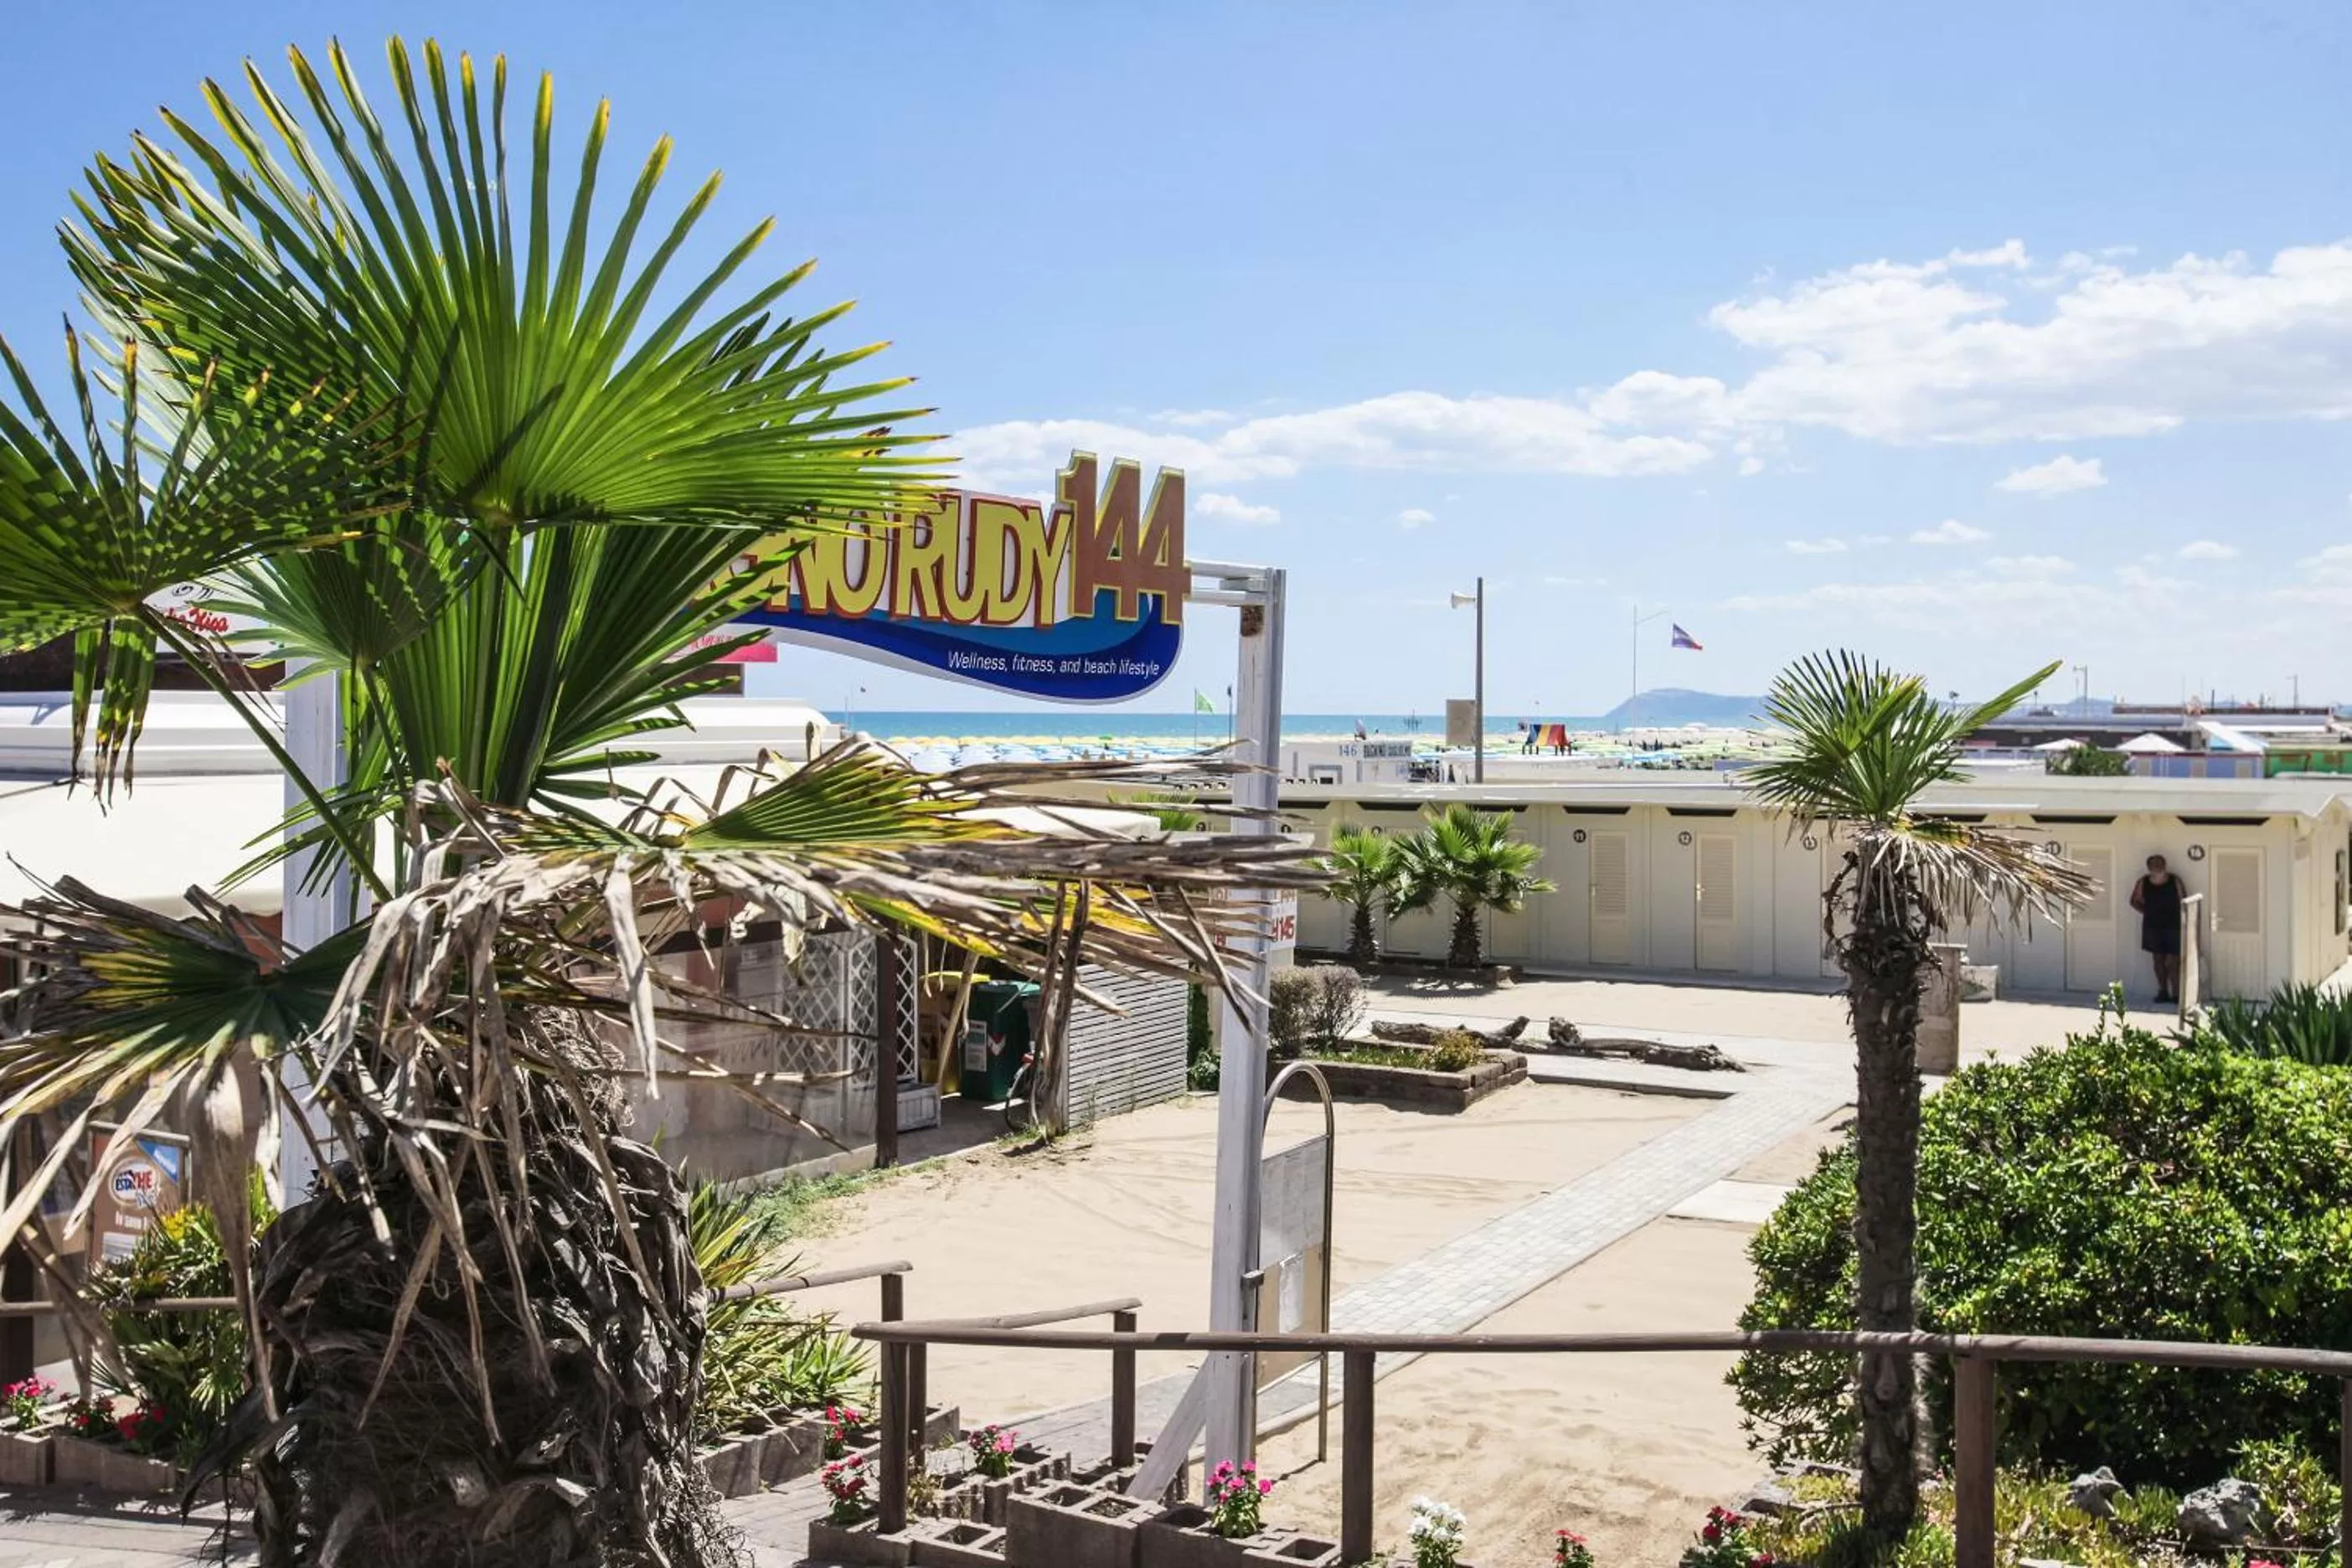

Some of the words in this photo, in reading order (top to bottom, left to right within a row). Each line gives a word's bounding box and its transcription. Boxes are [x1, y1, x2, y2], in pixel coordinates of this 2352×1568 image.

[890, 493, 1073, 629] RUDY
[1055, 448, 1192, 624] 144
[948, 651, 1008, 672] Wellness,
[1012, 653, 1055, 674] fitness,
[1060, 658, 1081, 673] and
[1085, 658, 1117, 674] beach
[1119, 658, 1159, 679] lifestyle
